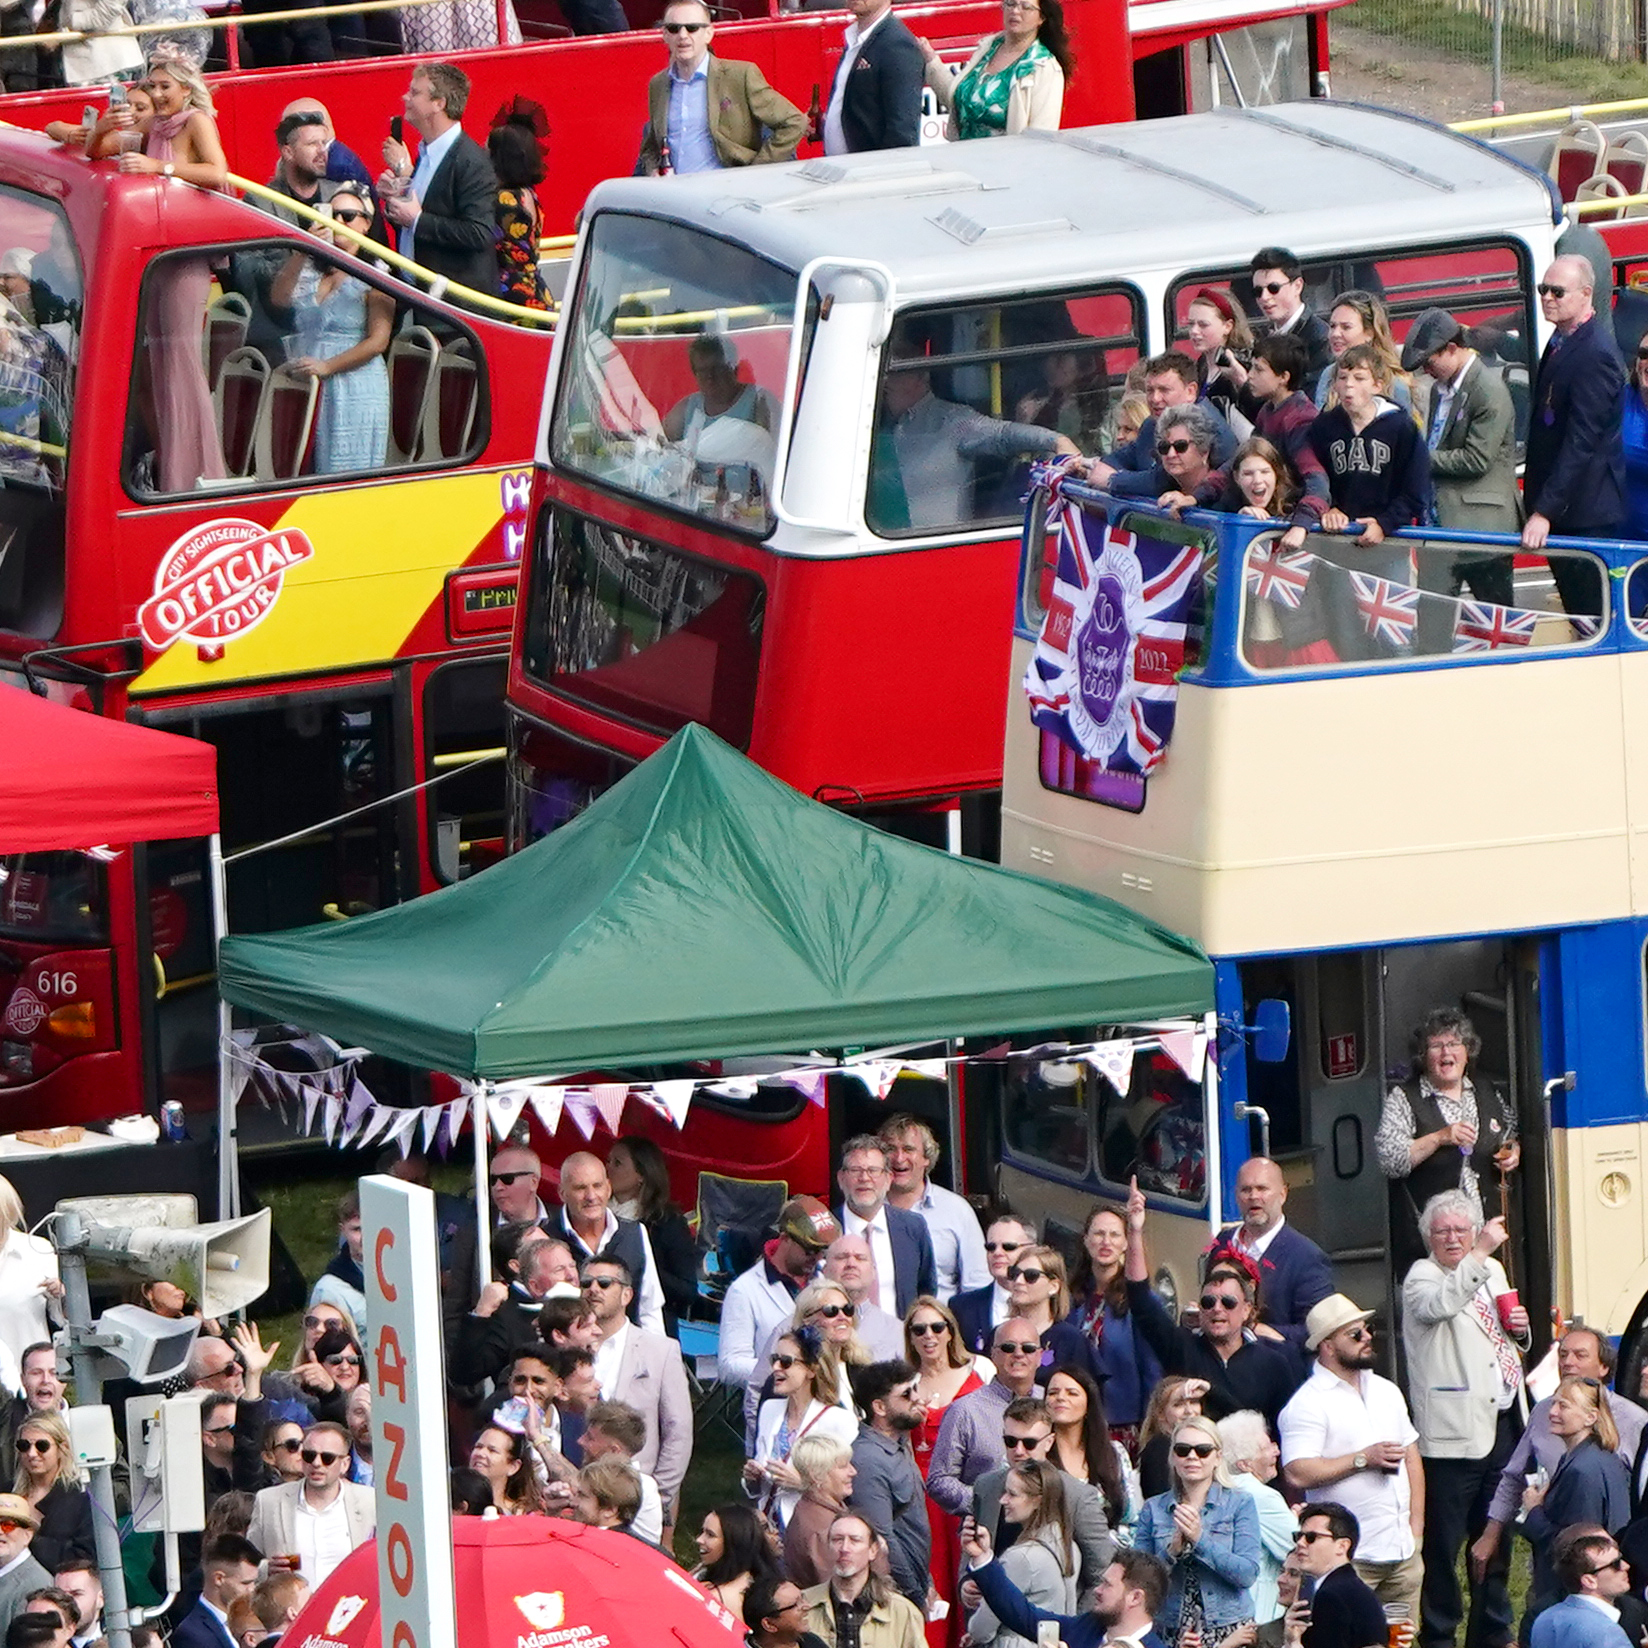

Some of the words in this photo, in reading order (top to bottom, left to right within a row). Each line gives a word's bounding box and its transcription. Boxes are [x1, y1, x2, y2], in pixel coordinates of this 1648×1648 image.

[1329, 436, 1391, 475] GAP
[167, 552, 188, 581] CITY
[185, 527, 259, 559] SIGHTSEEING
[156, 535, 304, 631] OFFICIAL
[210, 584, 275, 634] TOUR
[1139, 647, 1171, 673] 2022
[37, 970, 78, 995] 616
[7, 1001, 48, 1022] OFFICIAL
